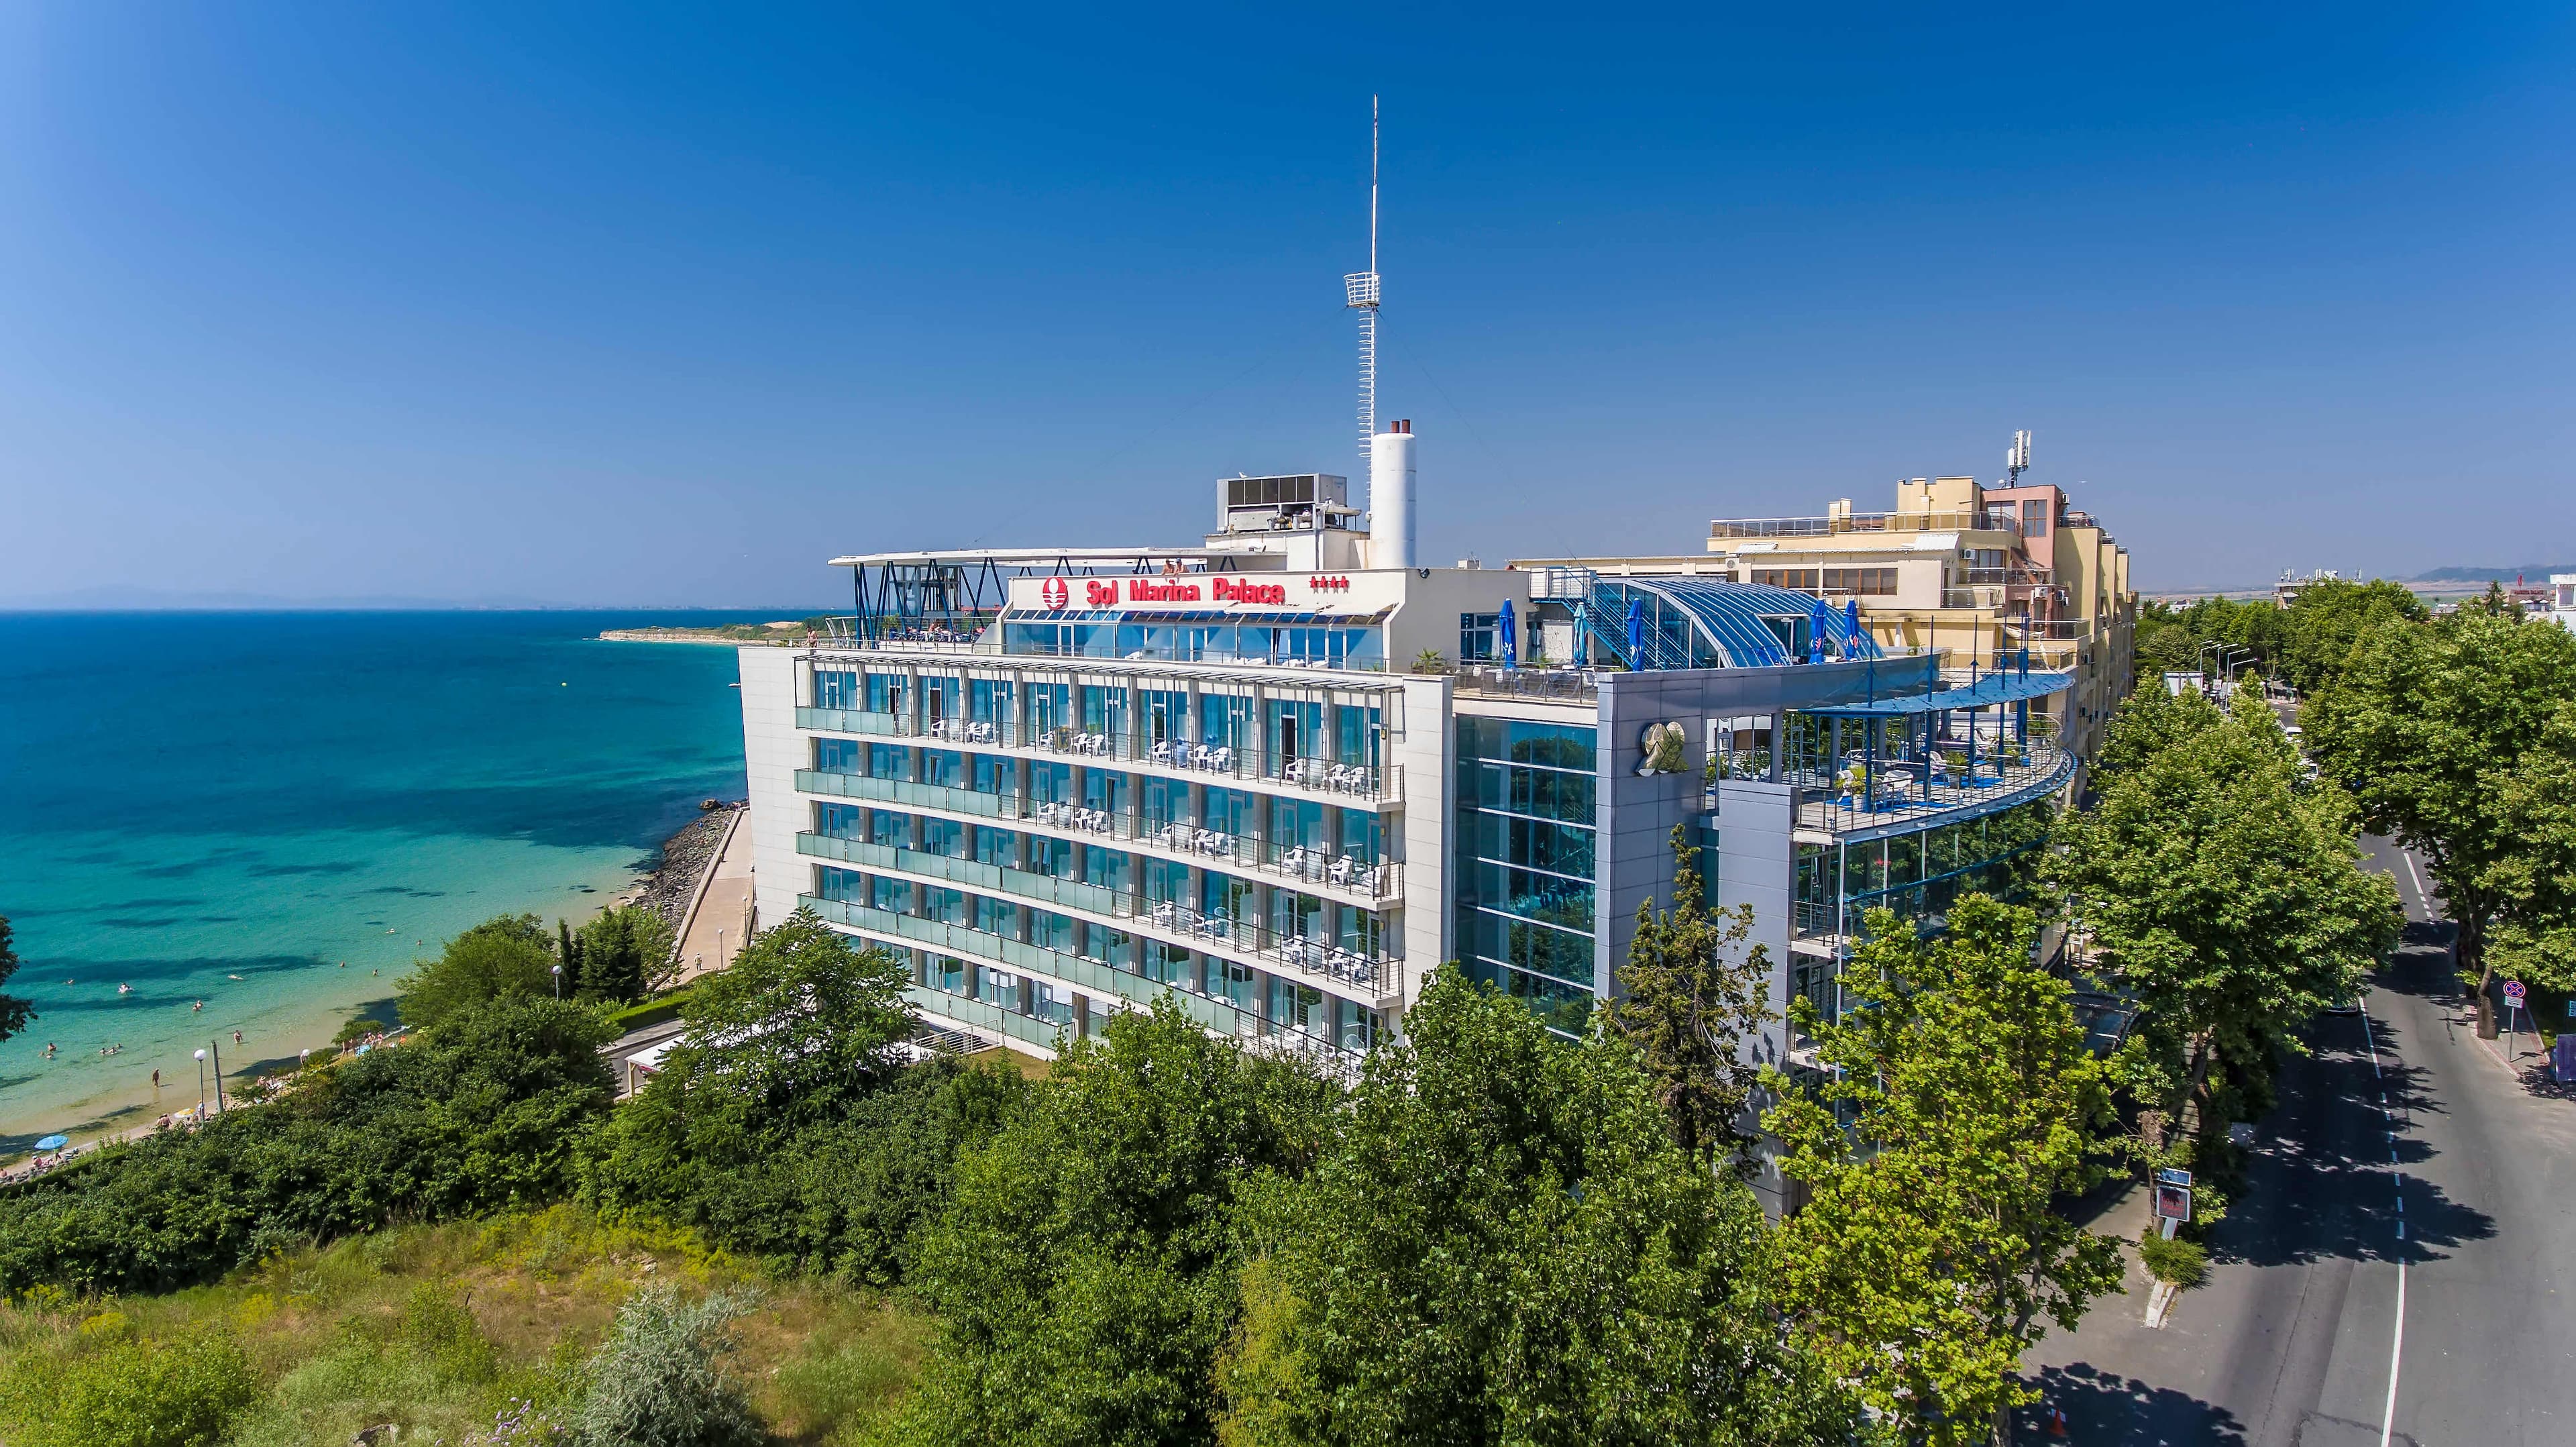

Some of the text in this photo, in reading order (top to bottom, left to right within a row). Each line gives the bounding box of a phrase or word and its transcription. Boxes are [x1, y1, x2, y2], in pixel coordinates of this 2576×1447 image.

[1087, 578, 1285, 605] Sol Marina Palace
